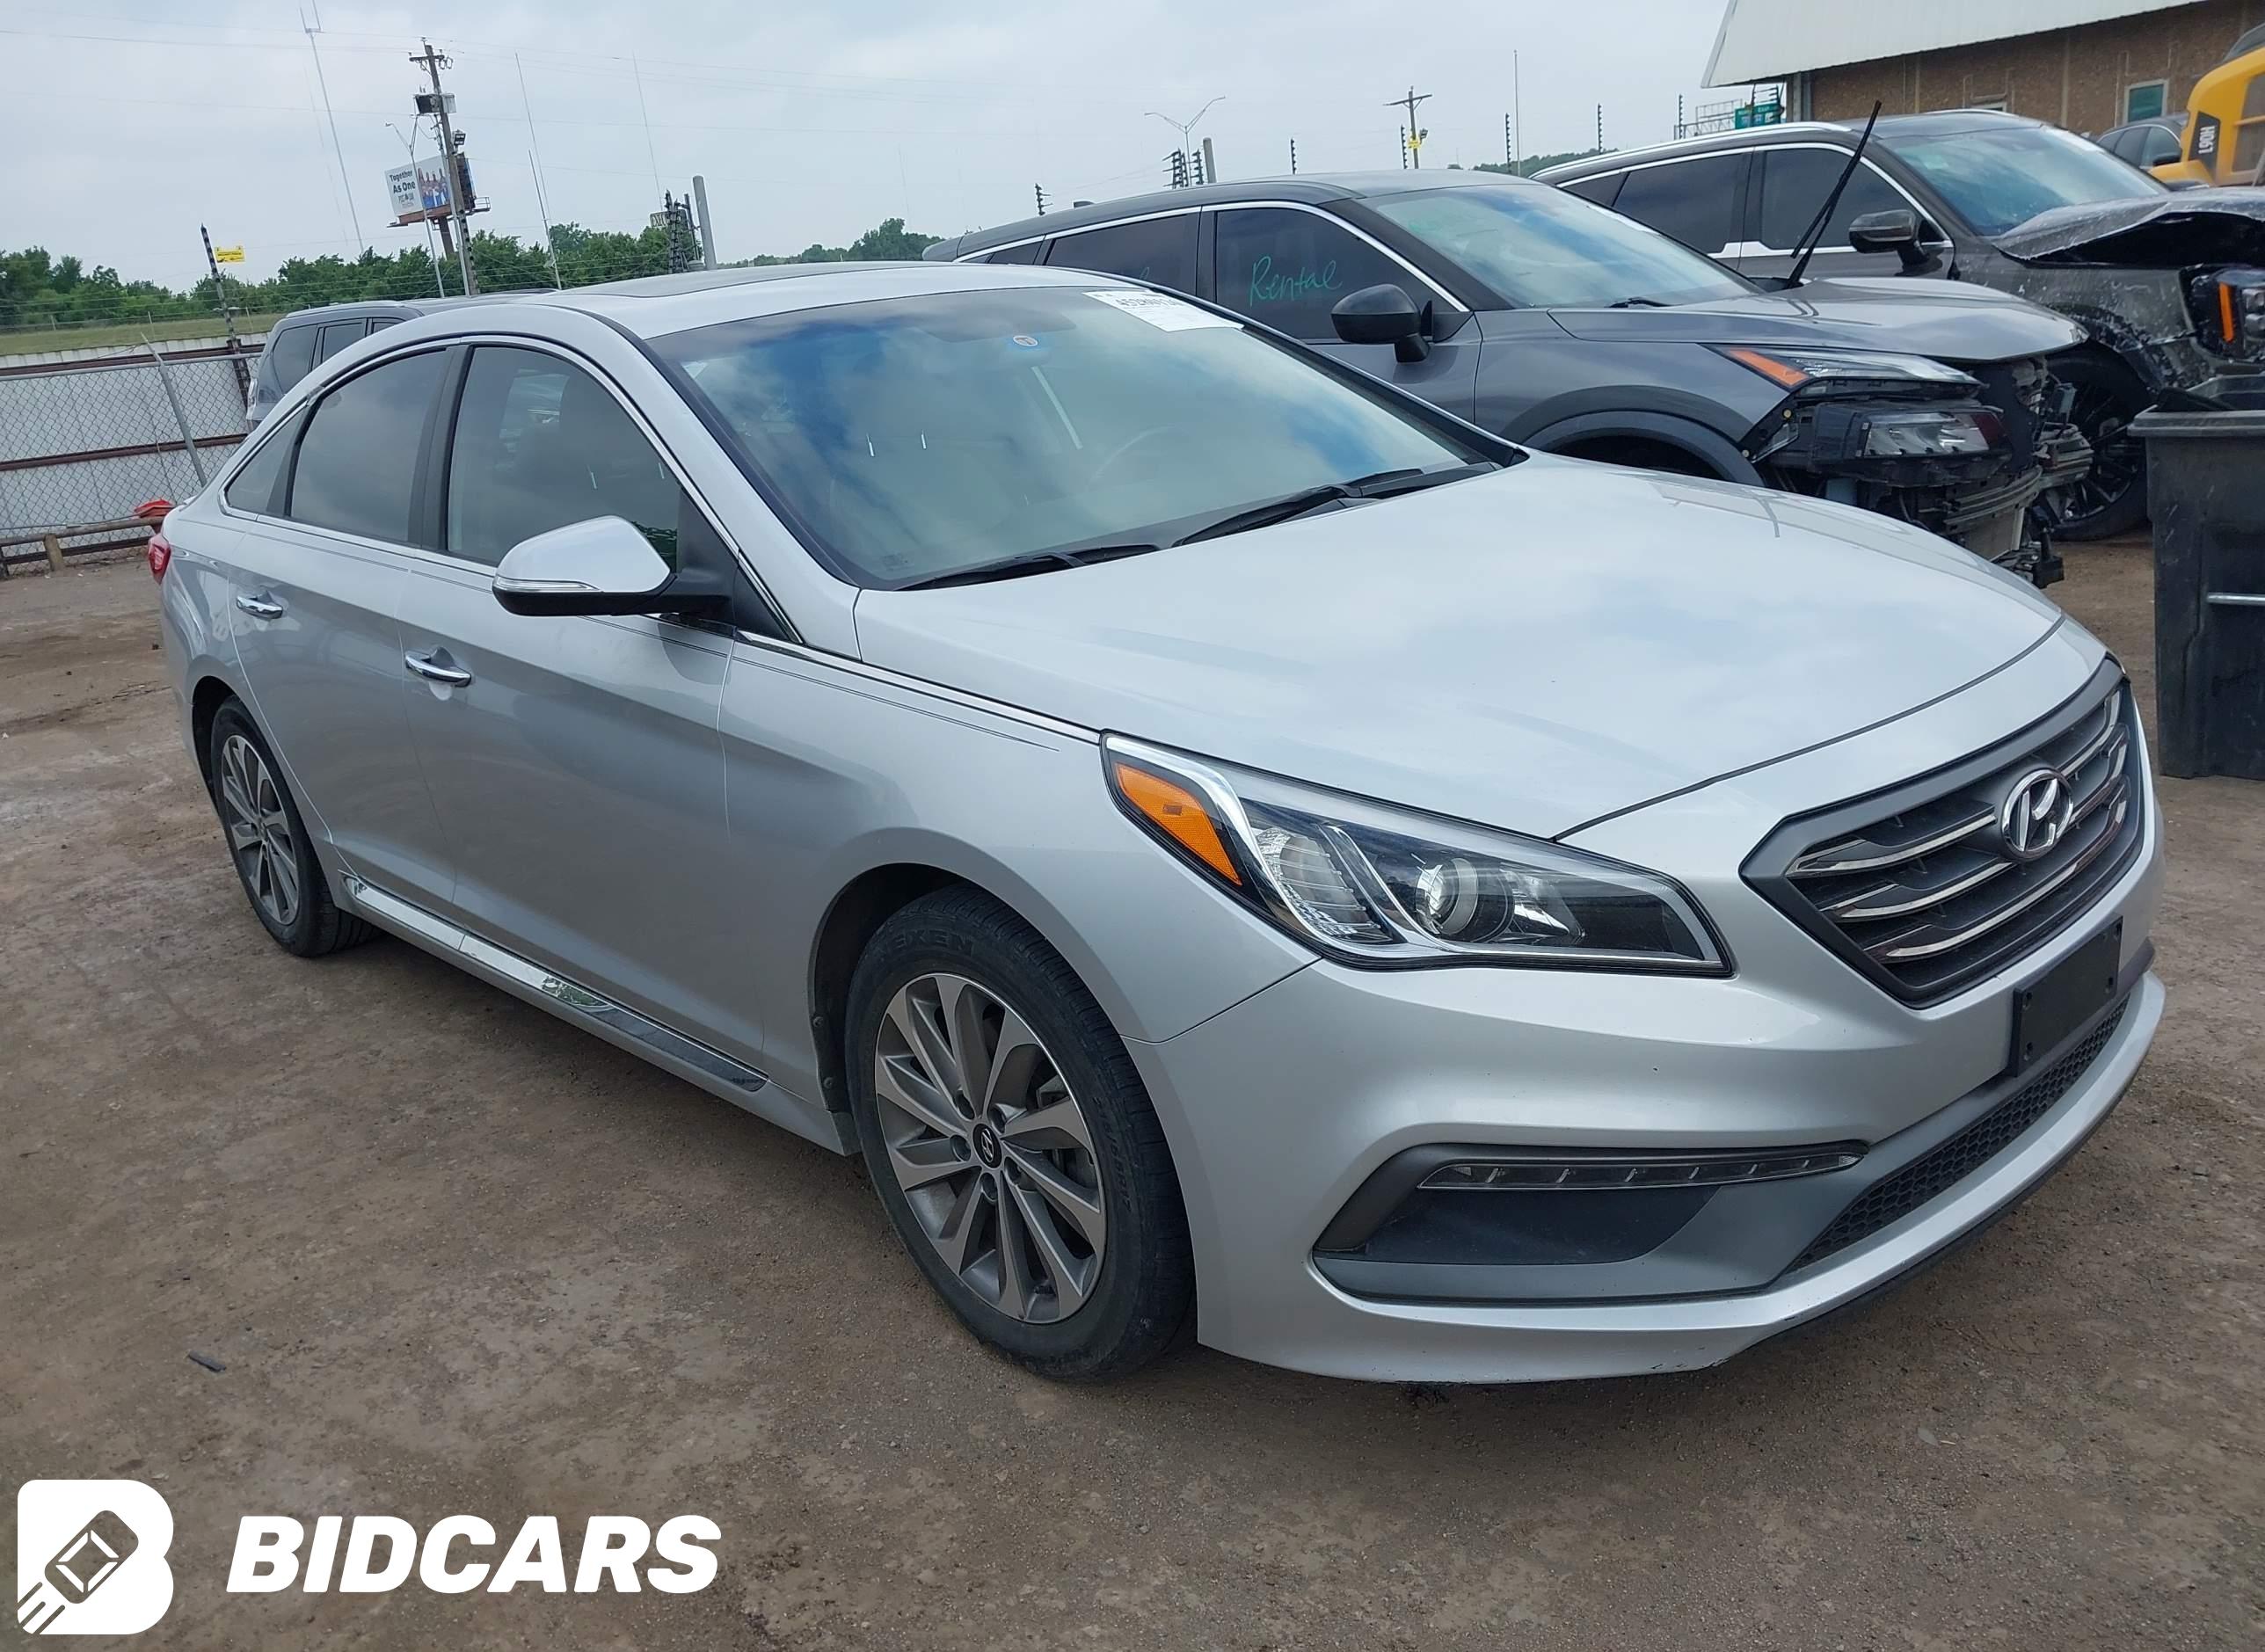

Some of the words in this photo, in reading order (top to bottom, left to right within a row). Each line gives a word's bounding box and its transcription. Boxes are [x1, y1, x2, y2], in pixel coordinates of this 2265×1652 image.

[390, 171, 413, 182] Together
[393, 185, 402, 193] As
[402, 181, 416, 191] One
[1249, 256, 1343, 307] Rental
